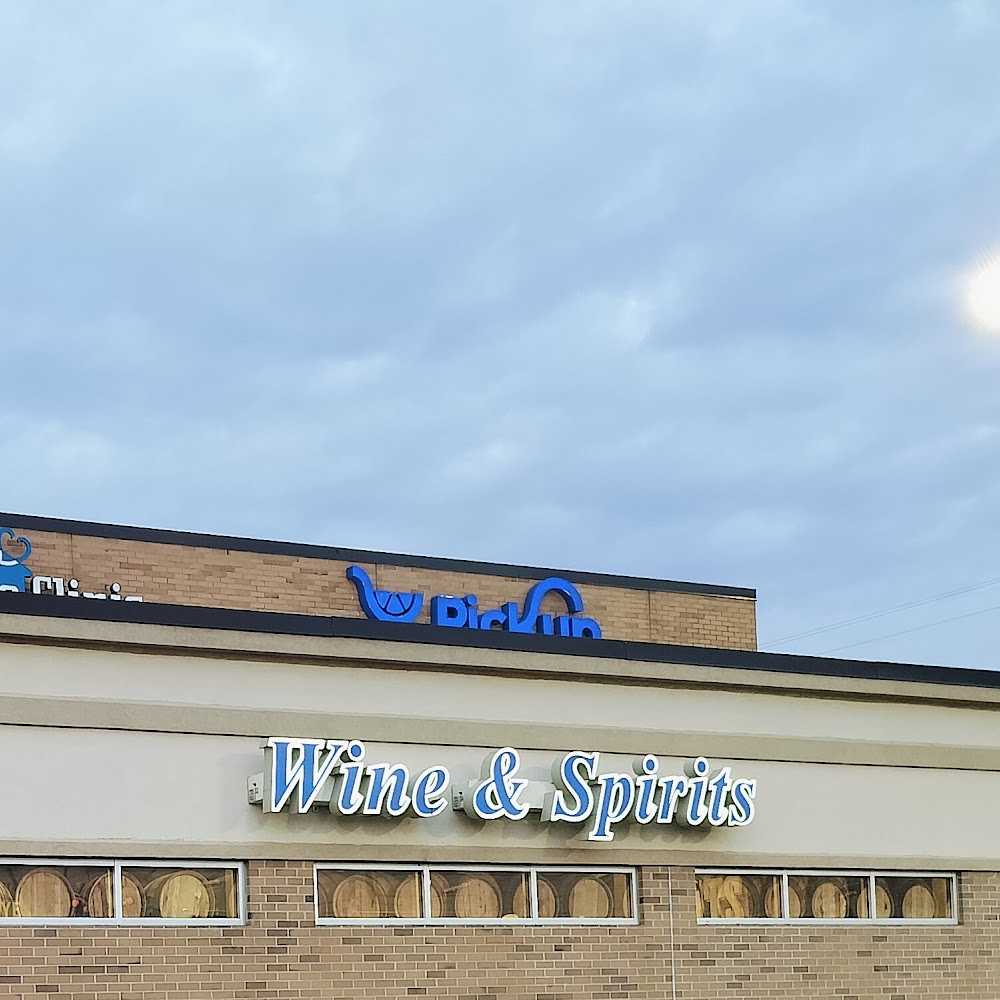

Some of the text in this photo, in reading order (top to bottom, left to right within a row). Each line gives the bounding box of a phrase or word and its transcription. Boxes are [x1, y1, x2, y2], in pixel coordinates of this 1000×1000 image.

[266, 737, 756, 841] Wine & Spirits
